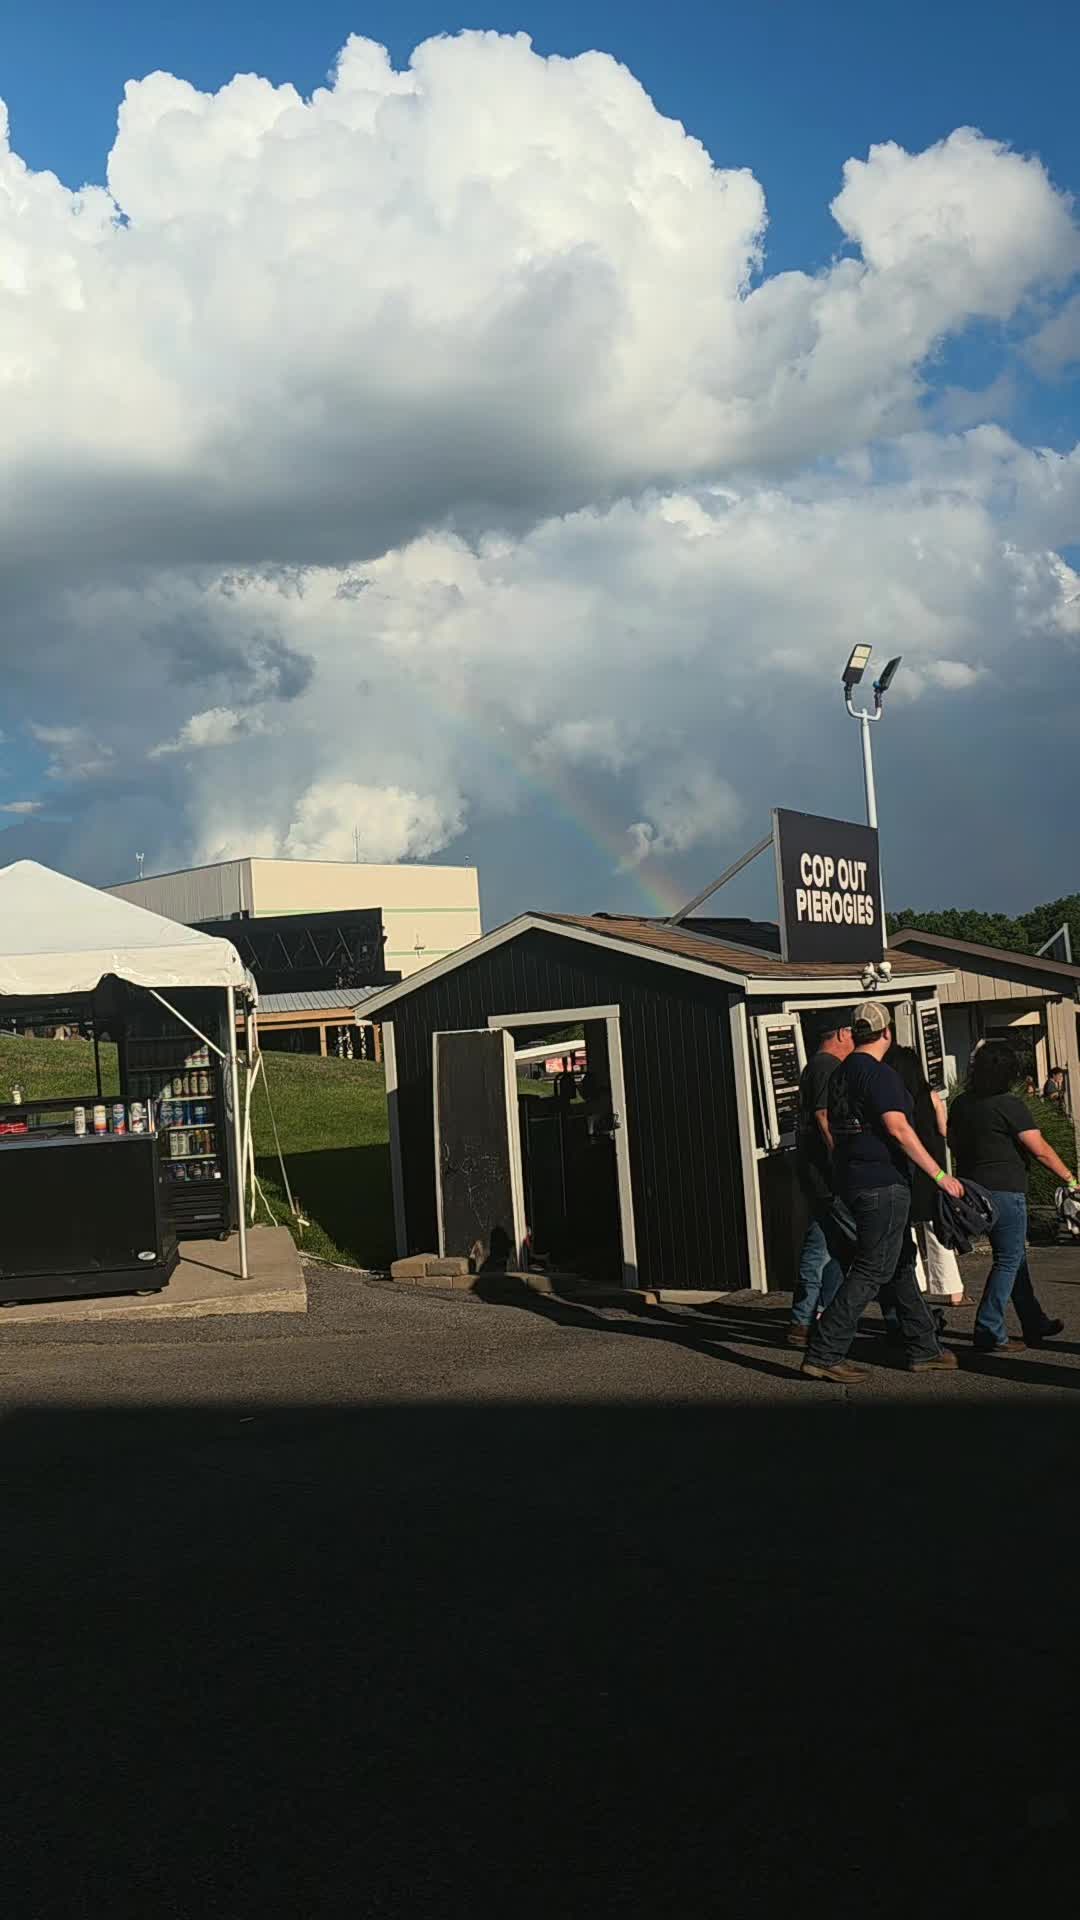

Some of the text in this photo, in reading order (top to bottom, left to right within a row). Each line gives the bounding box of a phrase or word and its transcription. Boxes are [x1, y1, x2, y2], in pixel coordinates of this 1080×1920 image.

[800, 852, 867, 891] COP OUT
[796, 888, 874, 926] PIEROGIES
